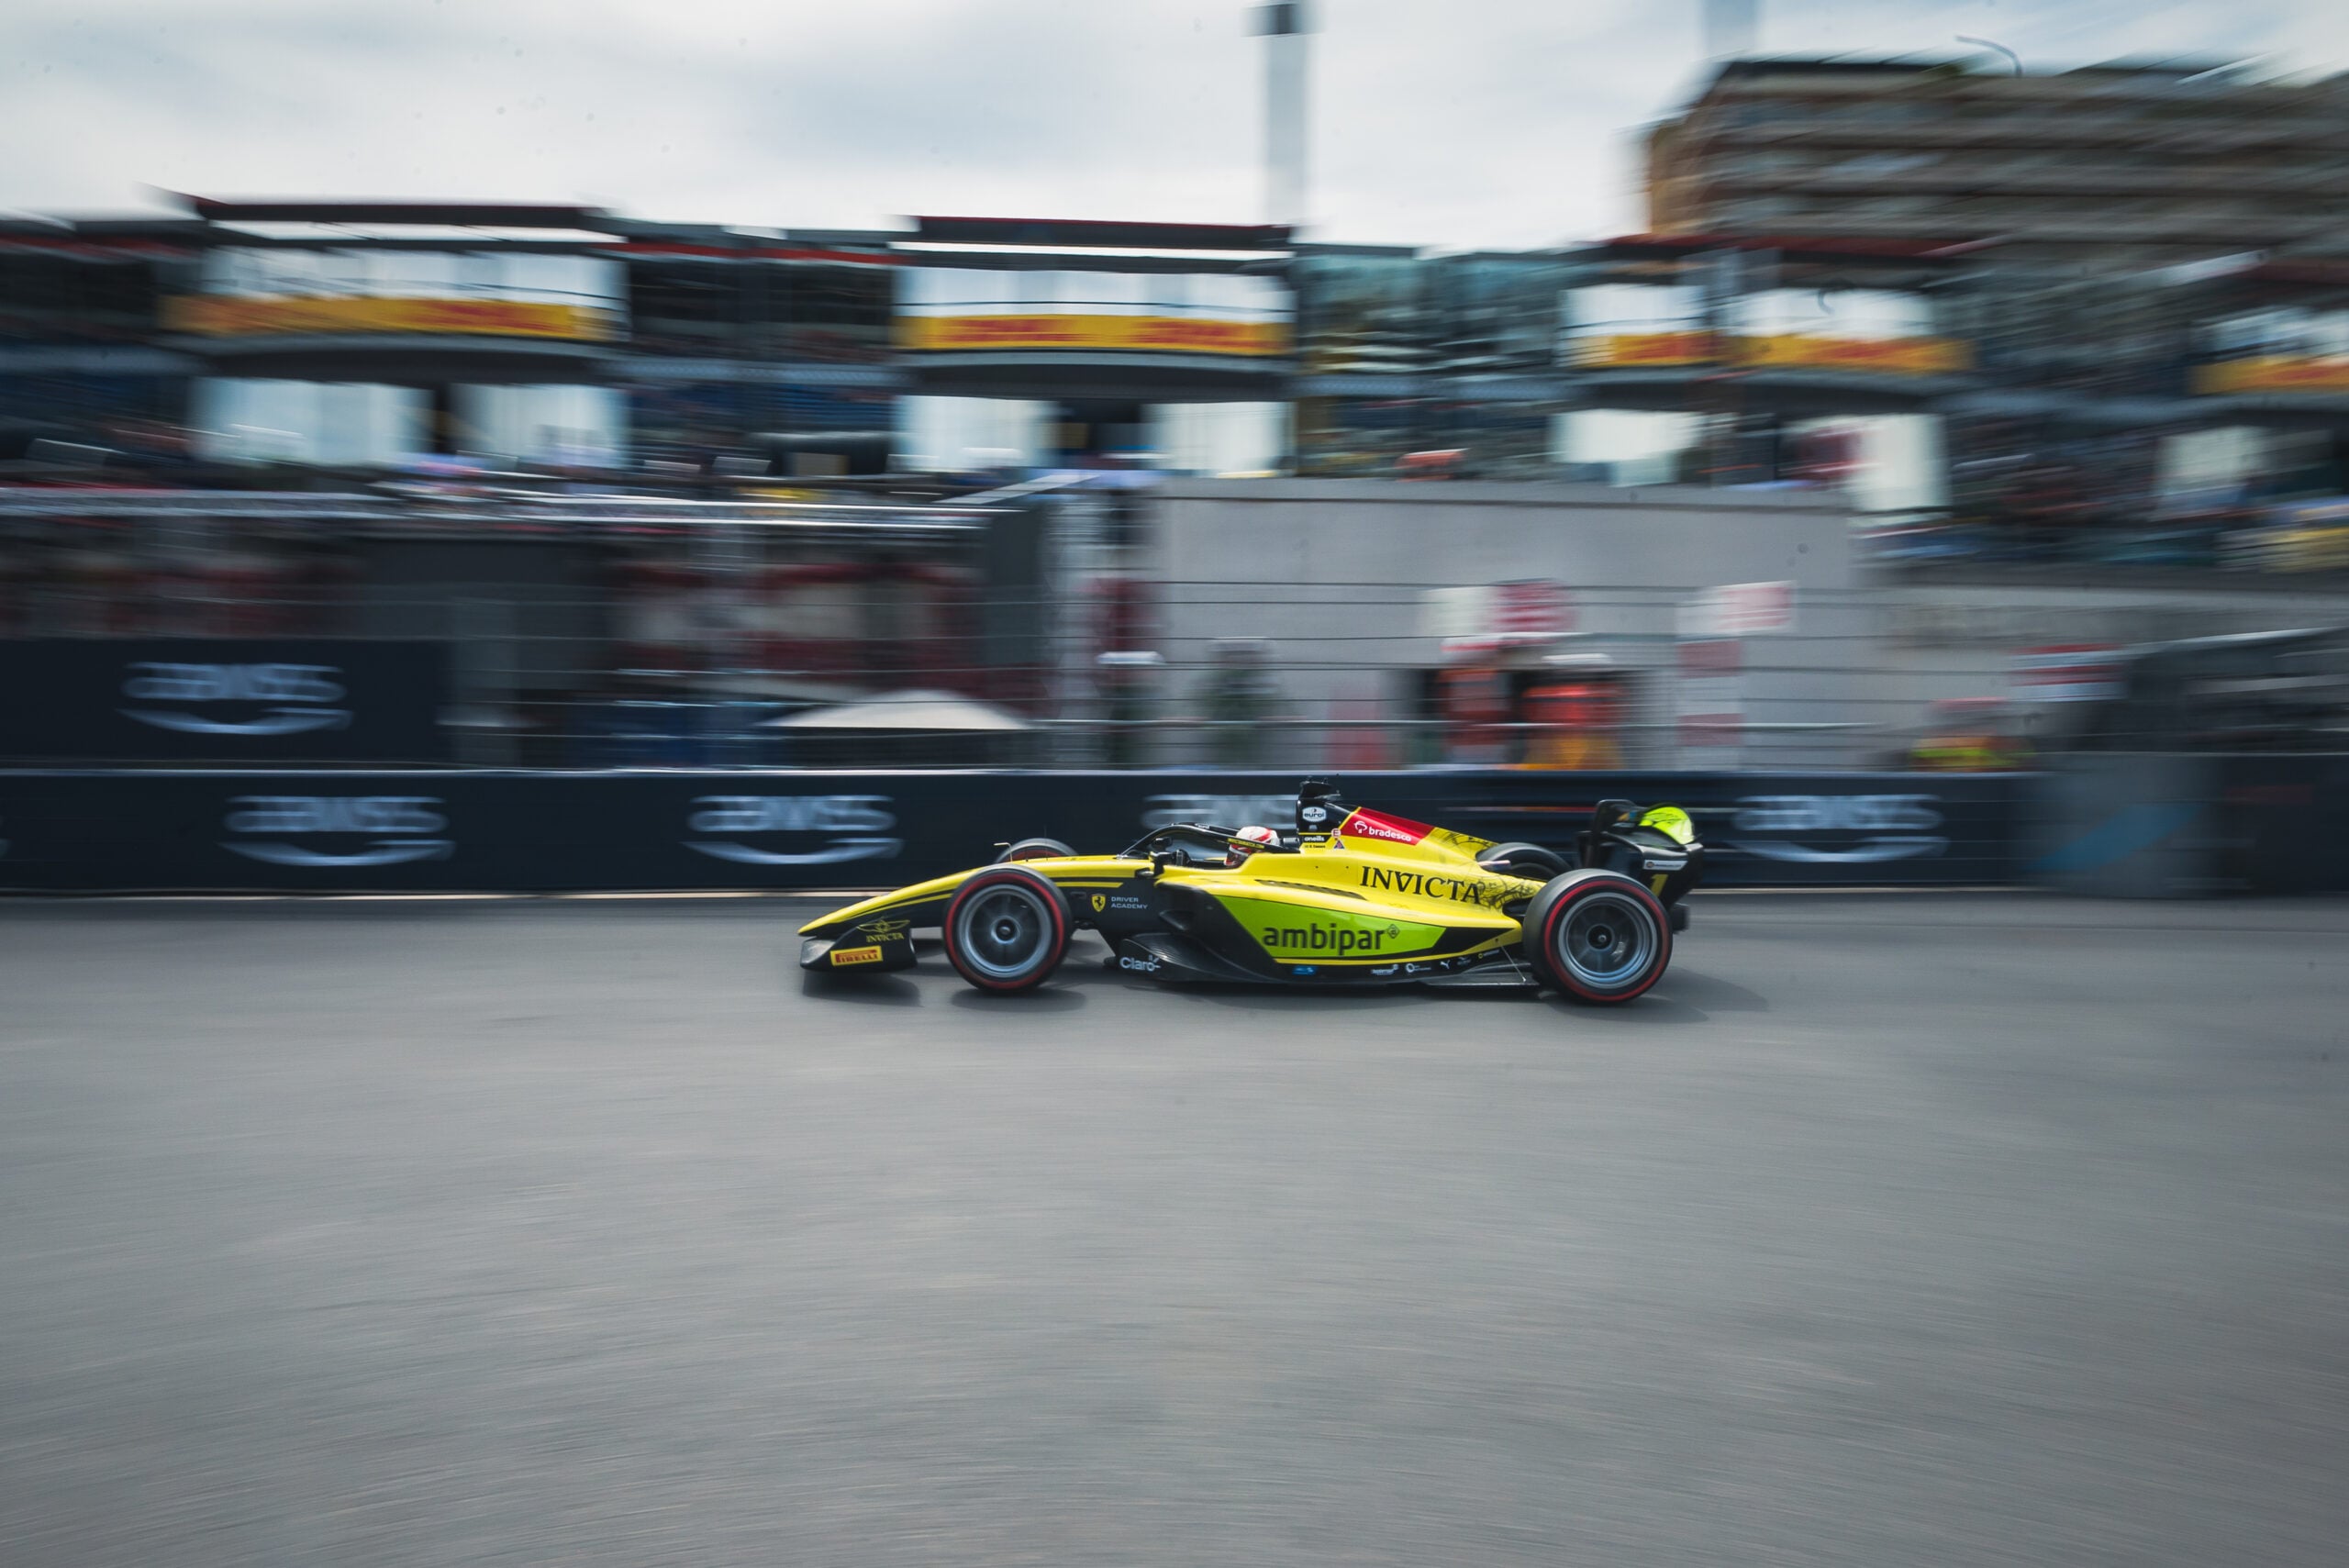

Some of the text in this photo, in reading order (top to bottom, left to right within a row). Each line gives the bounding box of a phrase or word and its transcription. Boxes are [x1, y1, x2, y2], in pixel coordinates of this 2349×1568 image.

[1368, 826, 1412, 842] bradesco
[1360, 865, 1483, 905] INVICTA
[1263, 923, 1386, 956] ambipar
[835, 950, 878, 963] PIRELLI
[1119, 956, 1156, 972] Claro
